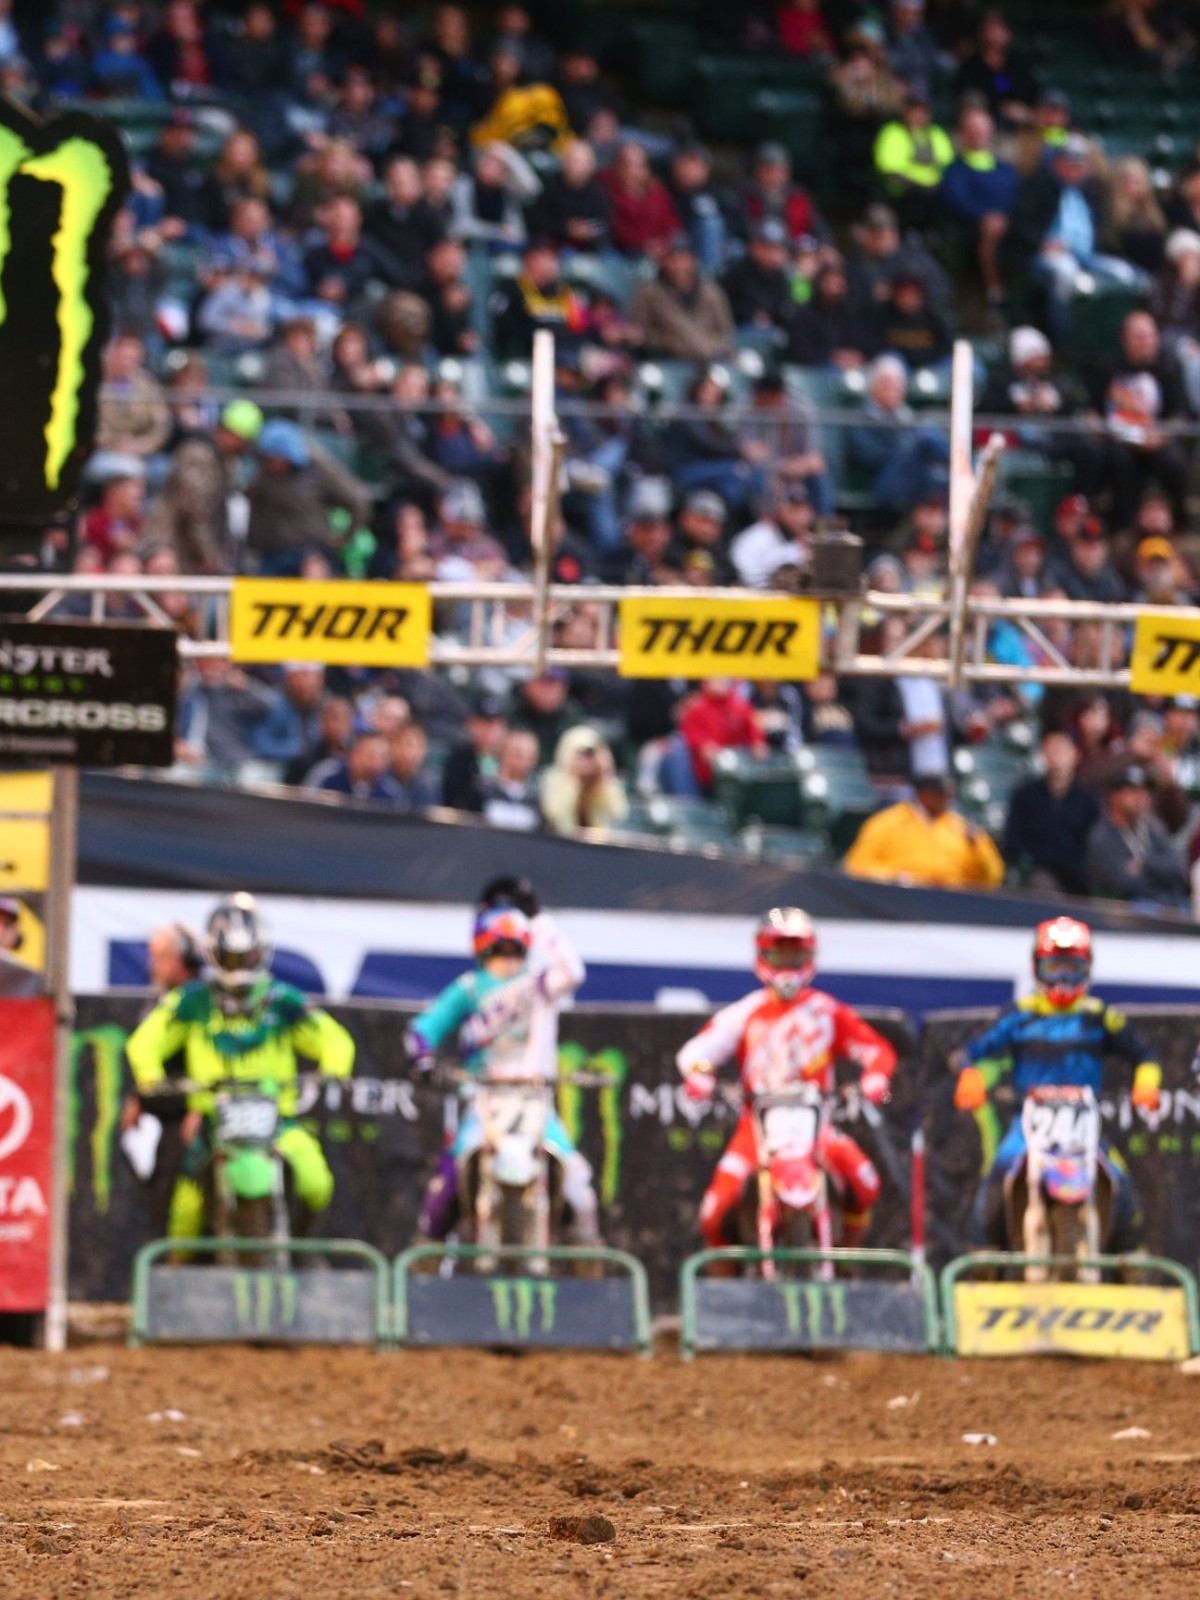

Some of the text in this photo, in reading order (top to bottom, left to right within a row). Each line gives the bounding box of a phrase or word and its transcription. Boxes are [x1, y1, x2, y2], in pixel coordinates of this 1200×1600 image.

[252, 603, 409, 641] THOR
[640, 618, 799, 656] THOR
[976, 1305, 1163, 1333] THOR
